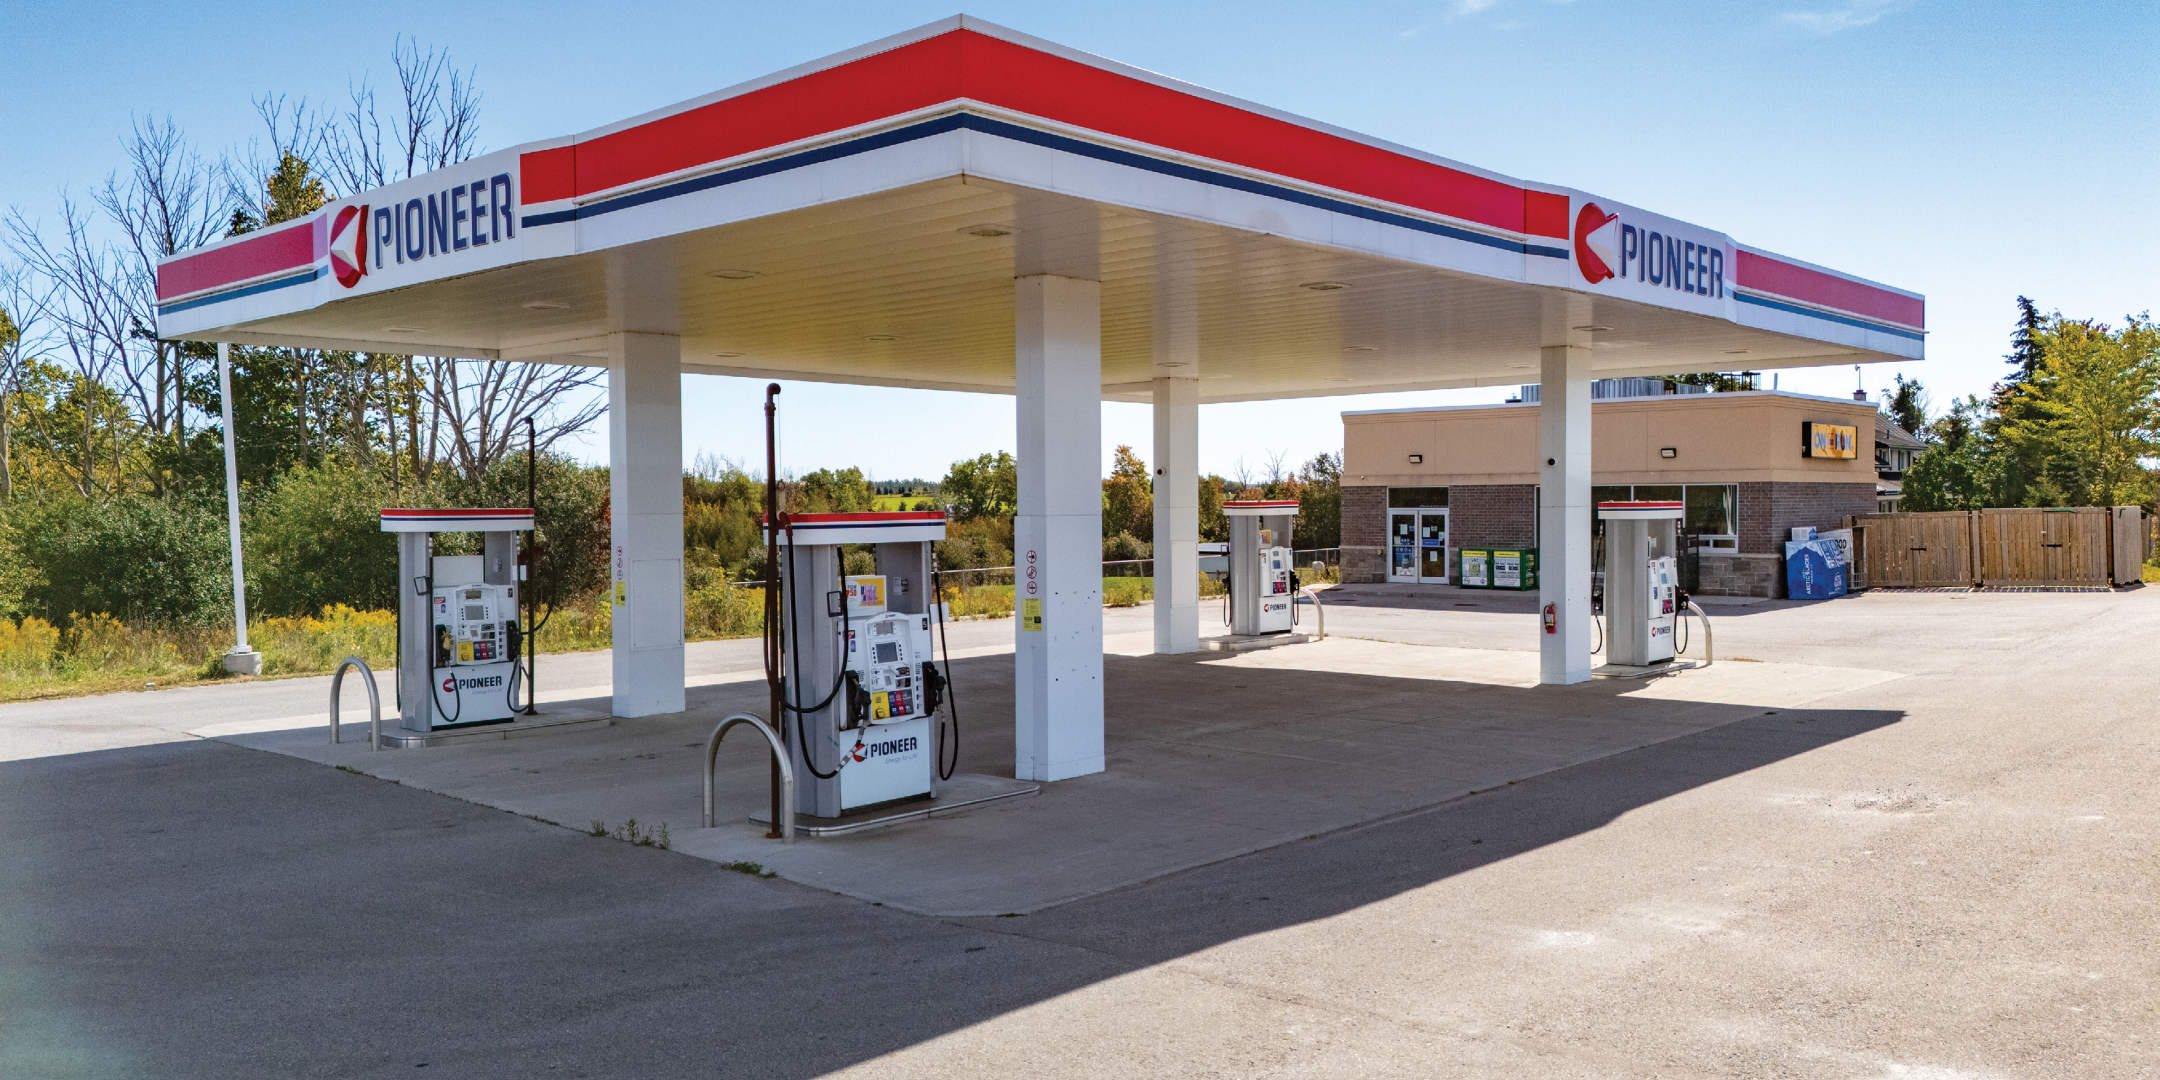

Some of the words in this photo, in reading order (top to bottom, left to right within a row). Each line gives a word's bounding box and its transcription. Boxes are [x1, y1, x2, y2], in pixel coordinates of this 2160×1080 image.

[374, 172, 515, 269] PIONEER
[1619, 223, 1724, 299] PIONEER
[1814, 431, 1826, 449] ON
[459, 676, 502, 690] PIONEER
[870, 736, 917, 757] PIONEER
